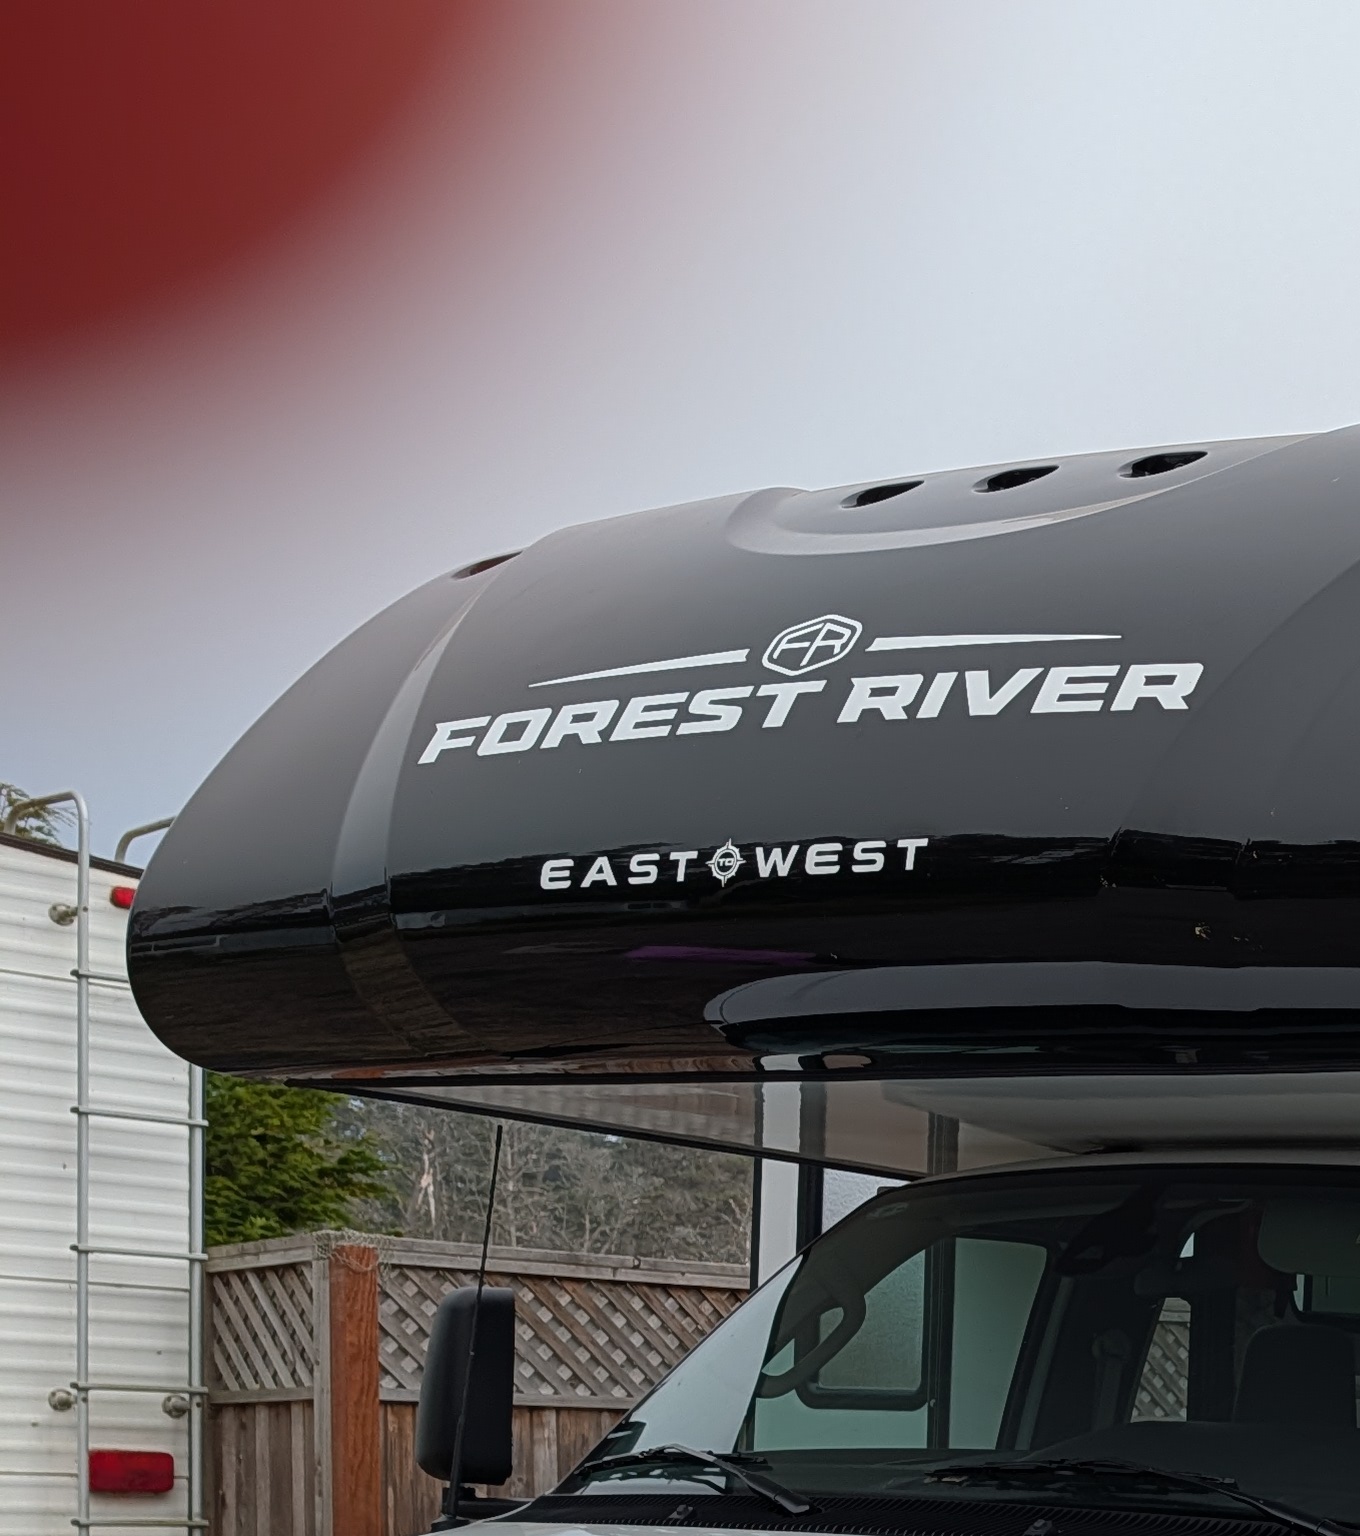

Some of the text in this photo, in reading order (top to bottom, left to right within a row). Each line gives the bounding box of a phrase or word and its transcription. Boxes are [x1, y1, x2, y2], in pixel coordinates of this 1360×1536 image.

[417, 661, 1205, 766] FOREST RIVER
[540, 849, 700, 891] EAST
[755, 837, 930, 879] WEST
